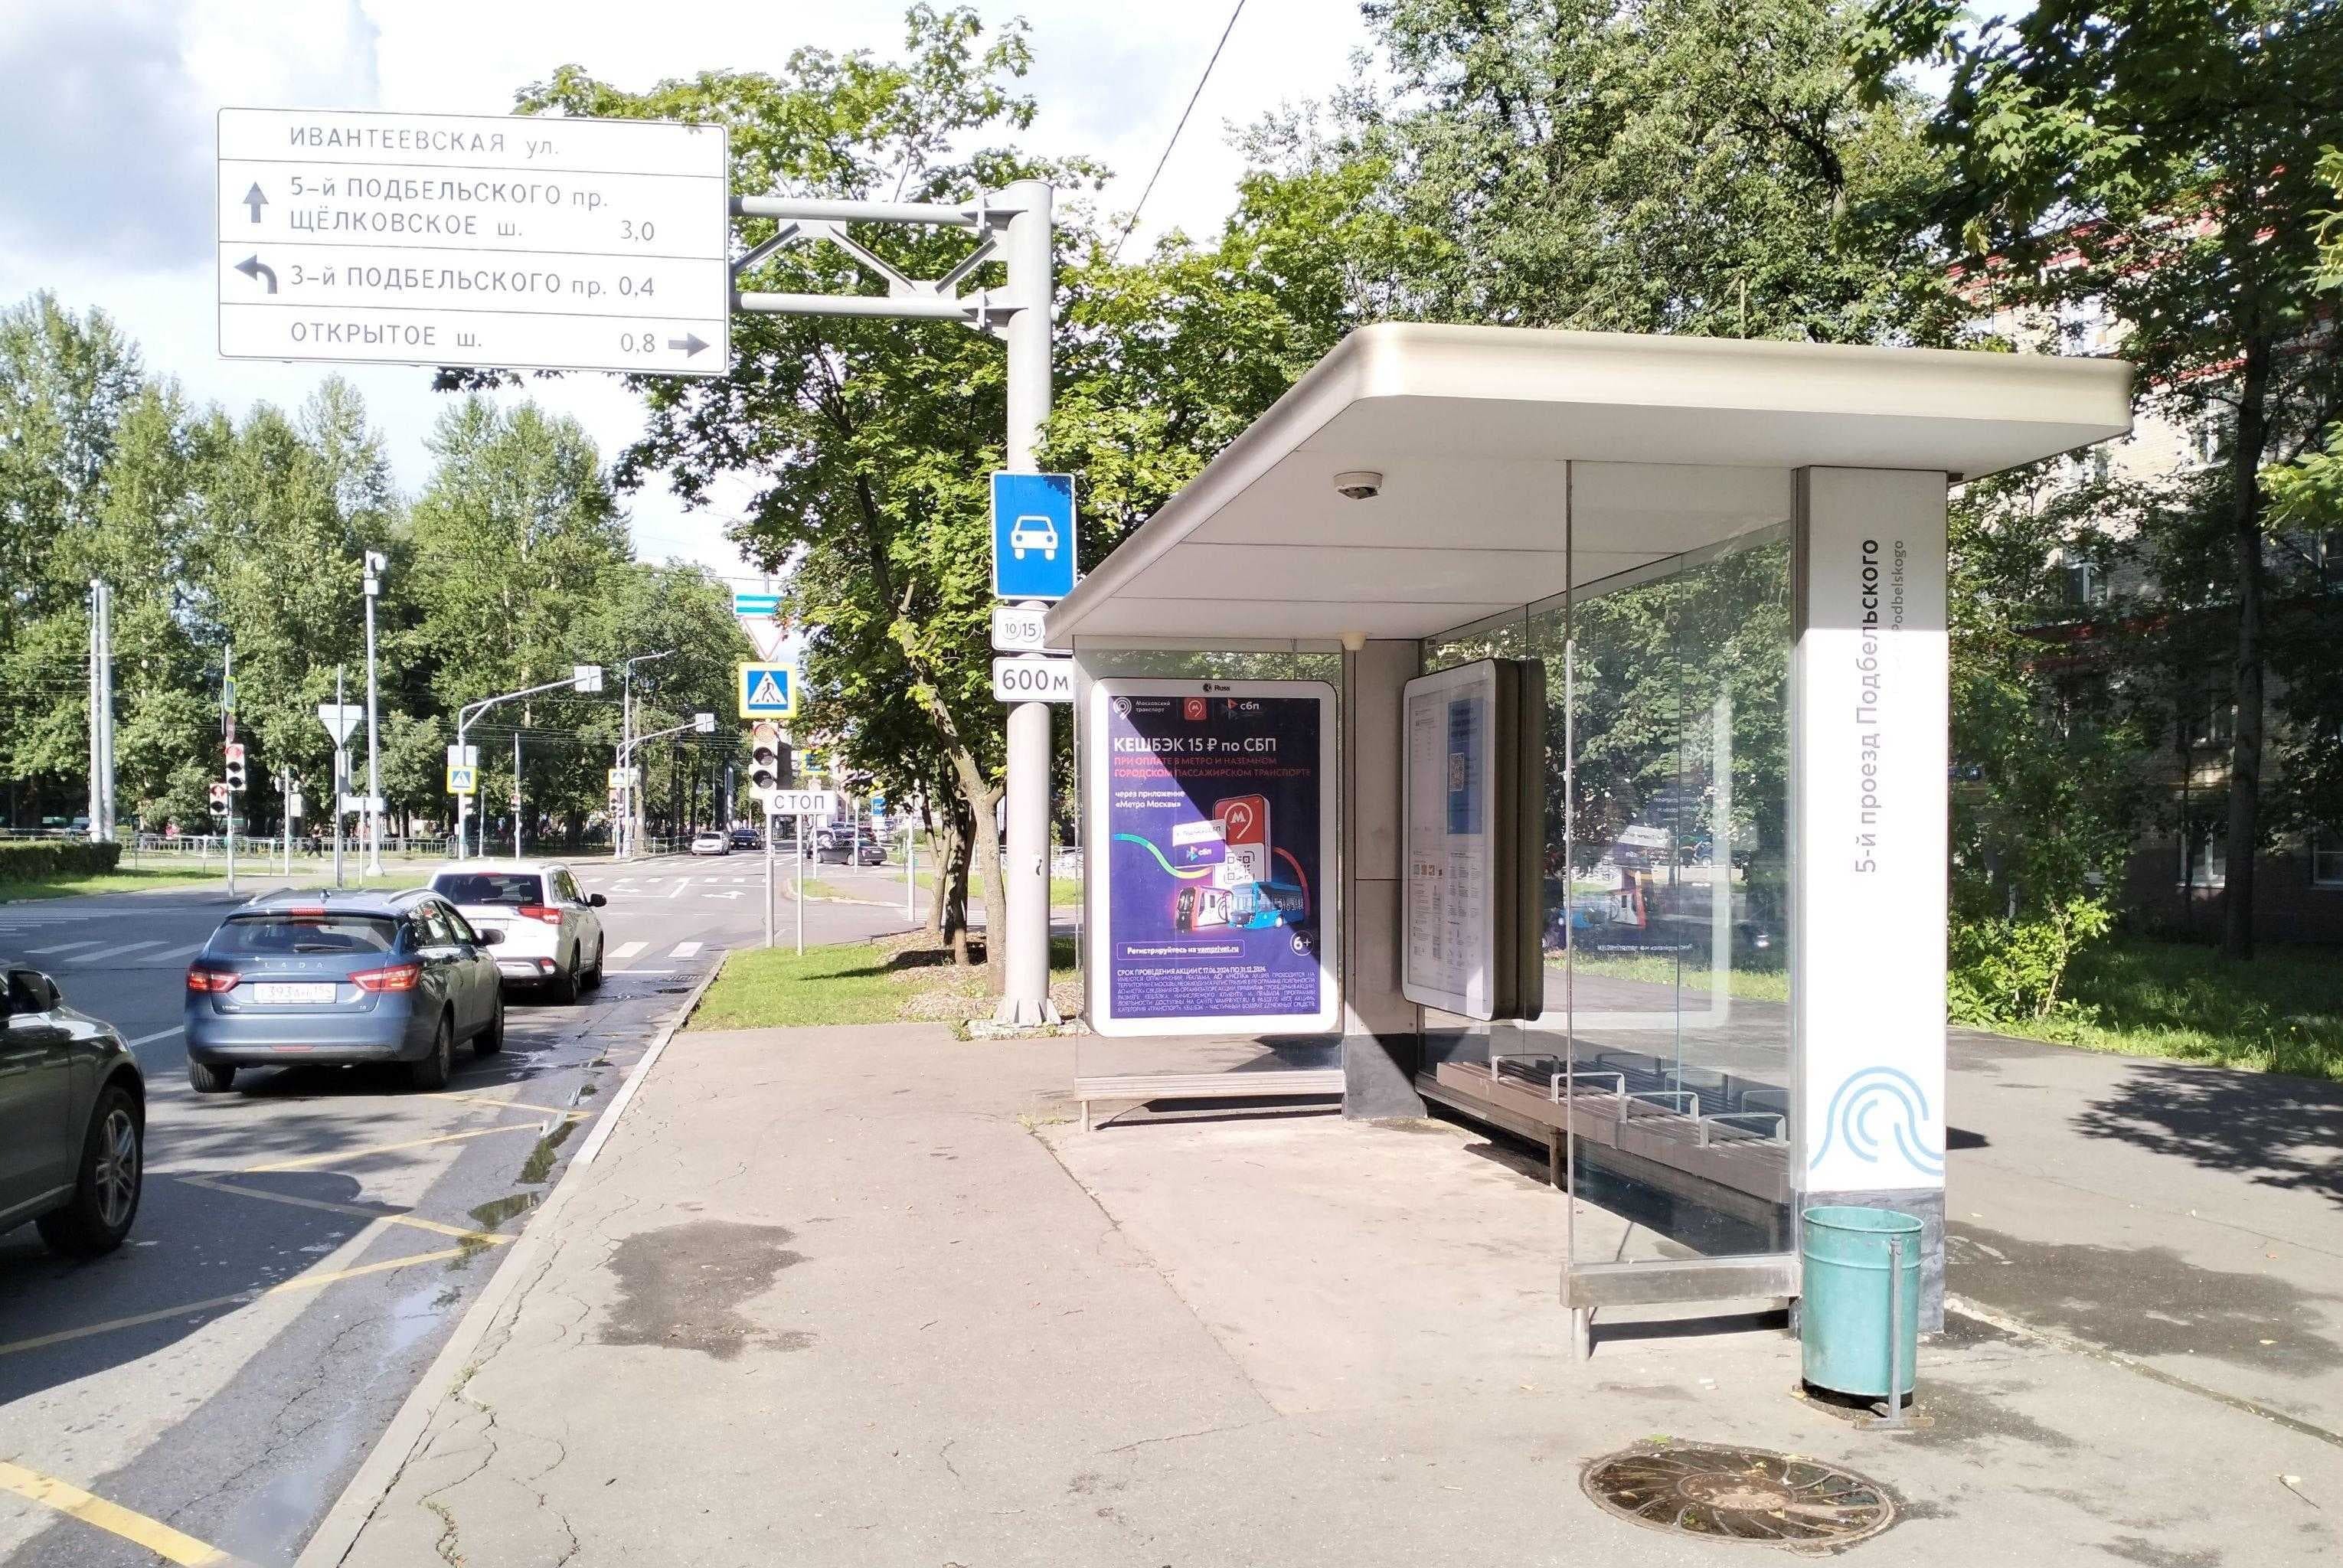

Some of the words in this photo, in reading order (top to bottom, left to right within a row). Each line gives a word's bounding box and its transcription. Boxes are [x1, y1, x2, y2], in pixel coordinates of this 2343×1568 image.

[290, 126, 505, 153] ИВАНТЕЕВСКАЯ
[526, 137, 559, 158] ул.
[290, 176, 335, 198] 5-й
[347, 178, 560, 205] ПОДБЕЛЬСКОГО
[572, 190, 609, 211] пр.
[290, 205, 477, 236] ЩЁЛКОВСКОЕ
[498, 220, 522, 237] ш.
[619, 220, 655, 244] 3,0
[290, 265, 335, 287] 3-й
[347, 266, 560, 296] ПОДБЕЛЬСКОГО
[572, 279, 607, 299] пр.
[618, 276, 655, 300] 0,4
[290, 322, 436, 347] ОТКРЫТОЕ
[456, 332, 482, 348] ш.
[619, 334, 655, 357] 0,8
[1021, 622, 1037, 637] 15
[1855, 538, 1881, 725] Подбельского
[1002, 668, 1049, 691] 600
[1240, 701, 1260, 710] сбп
[1114, 737, 1185, 753] КЕШБЭК
[1188, 738, 1204, 752] 15
[1221, 741, 1240, 753] по
[1243, 737, 1277, 752] СБП
[1114, 768, 1172, 779] ГОРОДСКОМ
[1861, 733, 1881, 825] проезд
[774, 795, 825, 809] СТОП
[1855, 834, 1878, 874] 5-й
[1293, 936, 1311, 950] 6+
